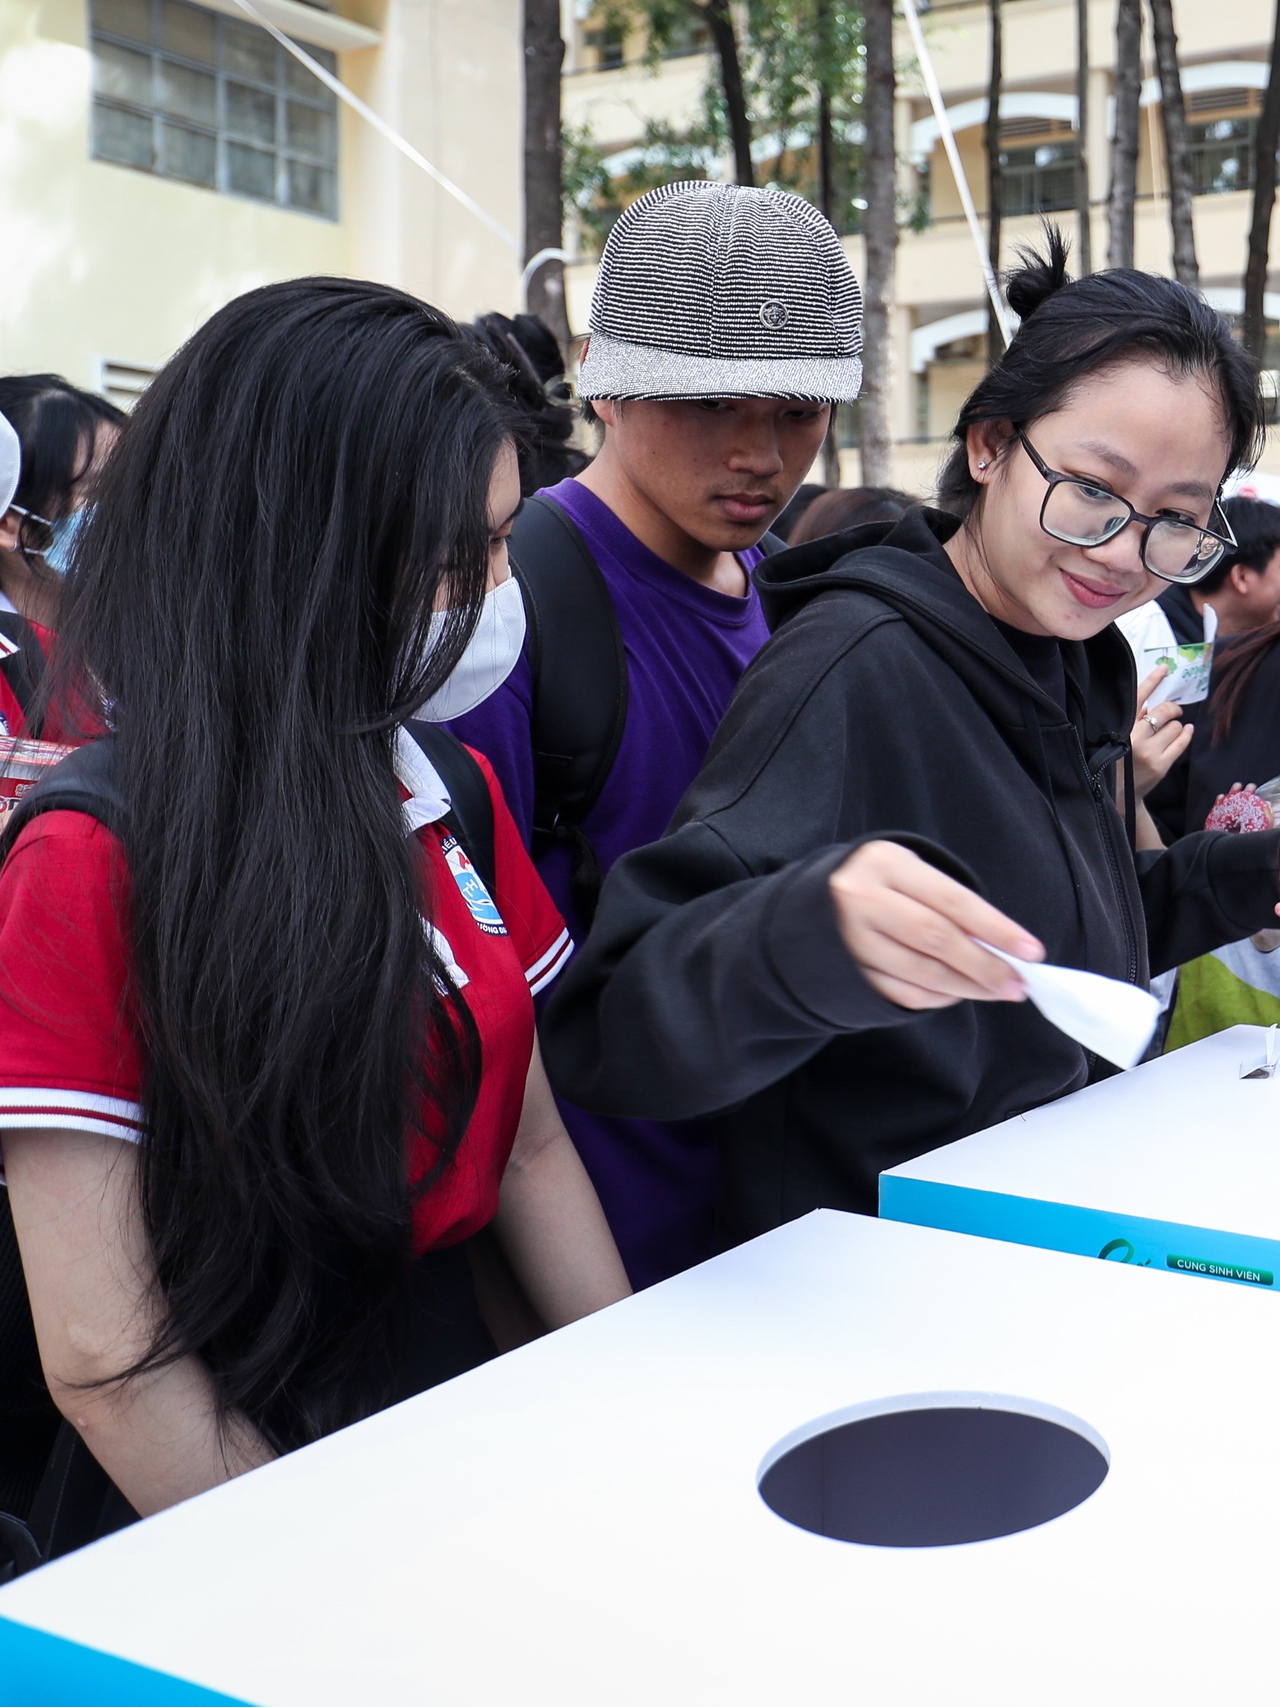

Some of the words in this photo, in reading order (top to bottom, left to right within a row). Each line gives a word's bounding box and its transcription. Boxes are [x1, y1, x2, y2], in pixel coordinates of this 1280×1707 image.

[1176, 1258, 1207, 1273] CÙNG
[1208, 1264, 1234, 1278] SINH
[1235, 1269, 1261, 1282] VIÊN
